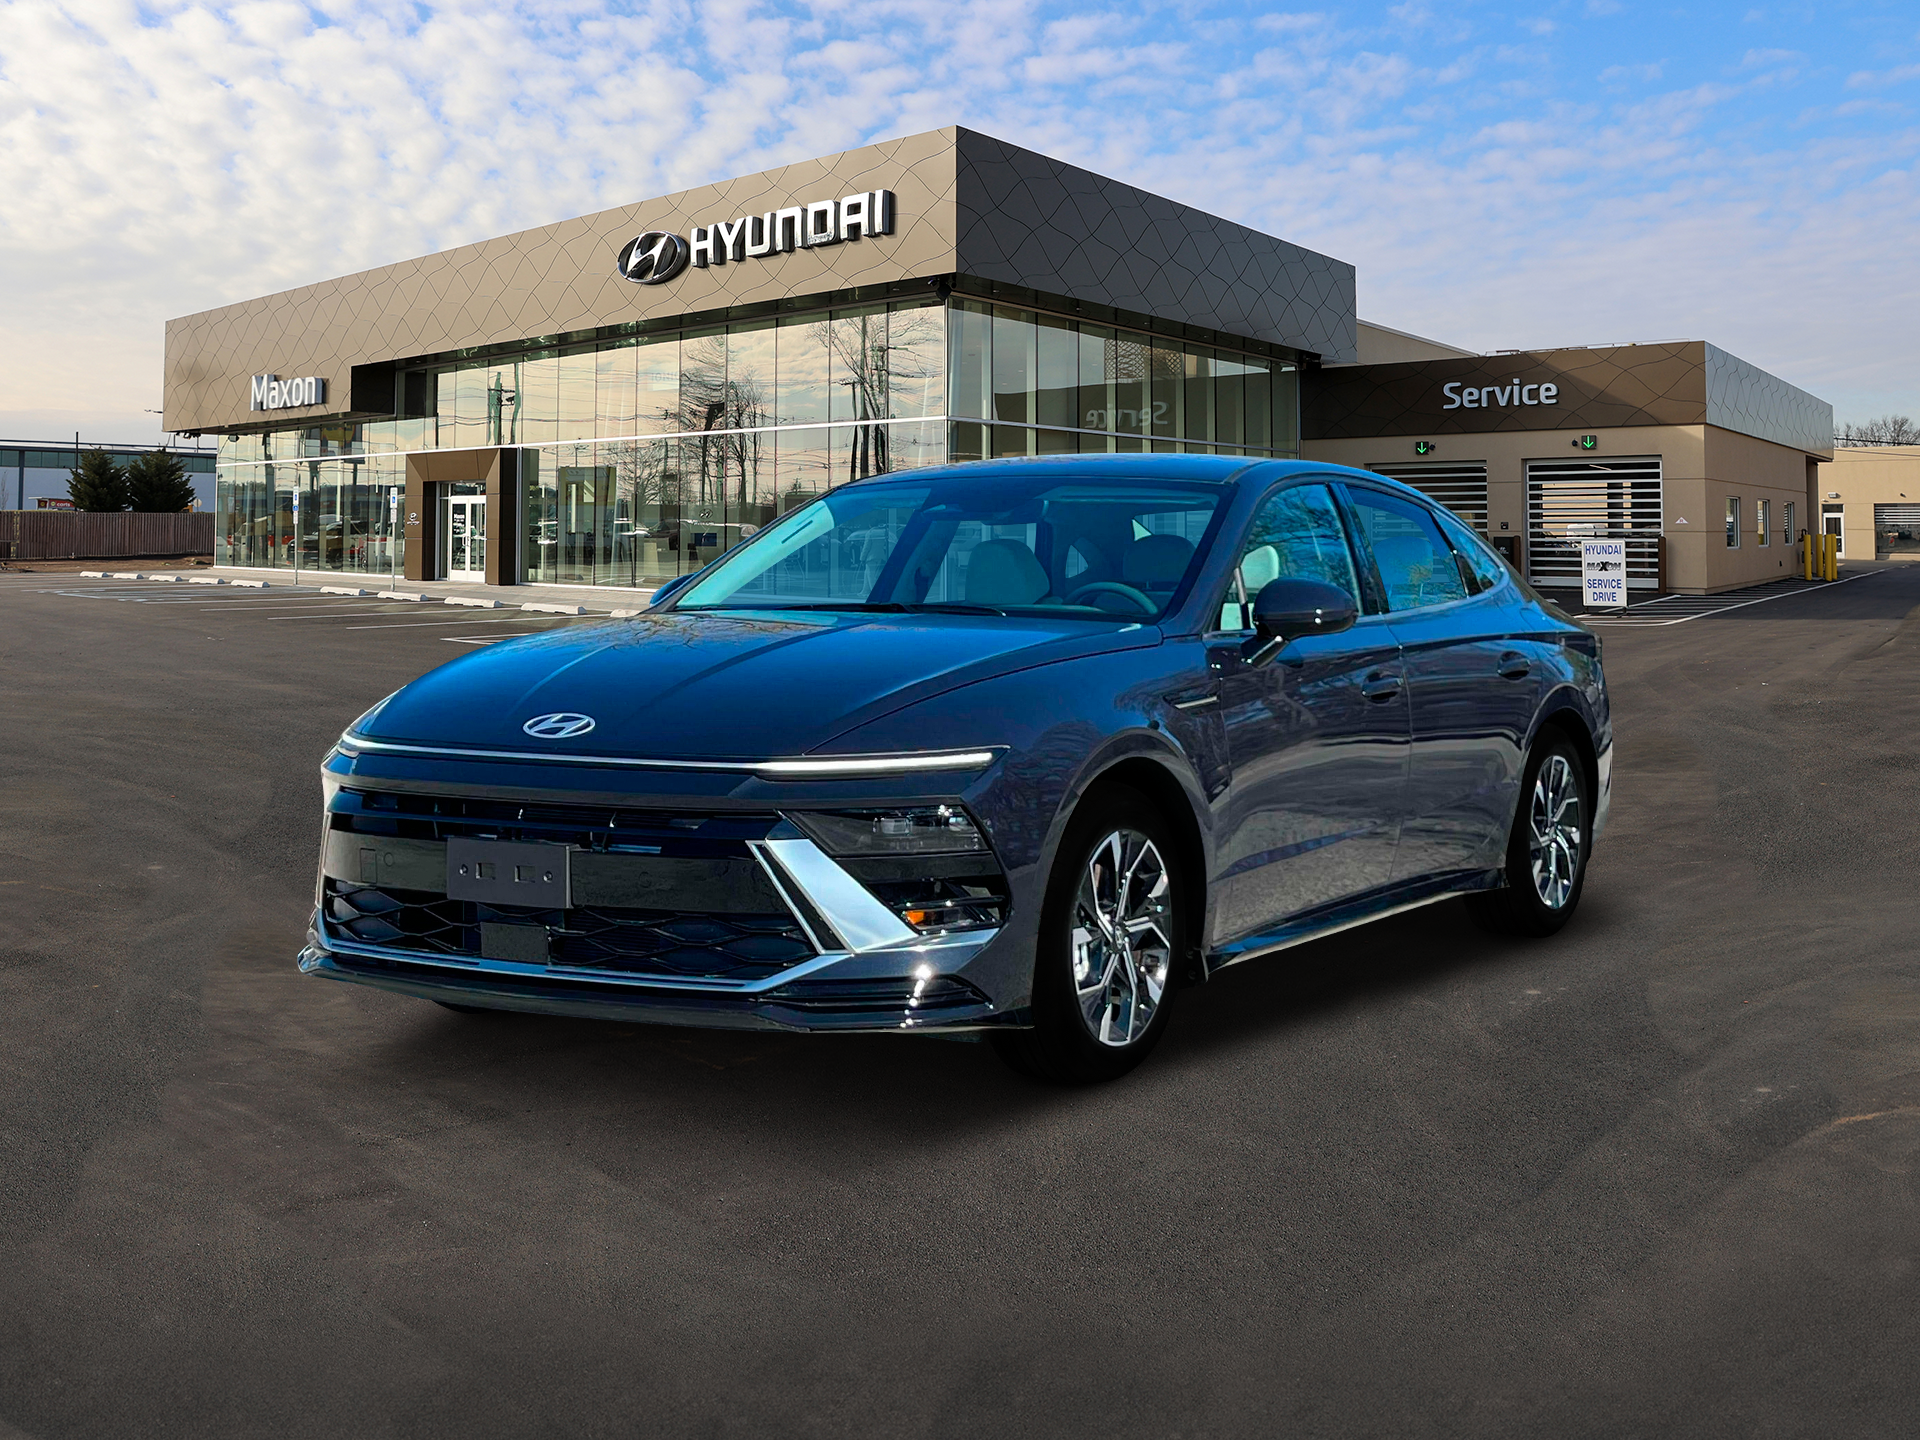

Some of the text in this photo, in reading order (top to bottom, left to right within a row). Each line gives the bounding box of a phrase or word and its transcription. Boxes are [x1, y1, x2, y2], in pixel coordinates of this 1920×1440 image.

[690, 189, 892, 267] HYUNDAI
[250, 374, 319, 411] Maxon
[1443, 378, 1558, 409] Service
[1585, 545, 1622, 555] HYUNDAI
[1586, 561, 1622, 571] MAXON
[1587, 579, 1622, 589] SERVICE
[1592, 592, 1617, 602] DRIVE
